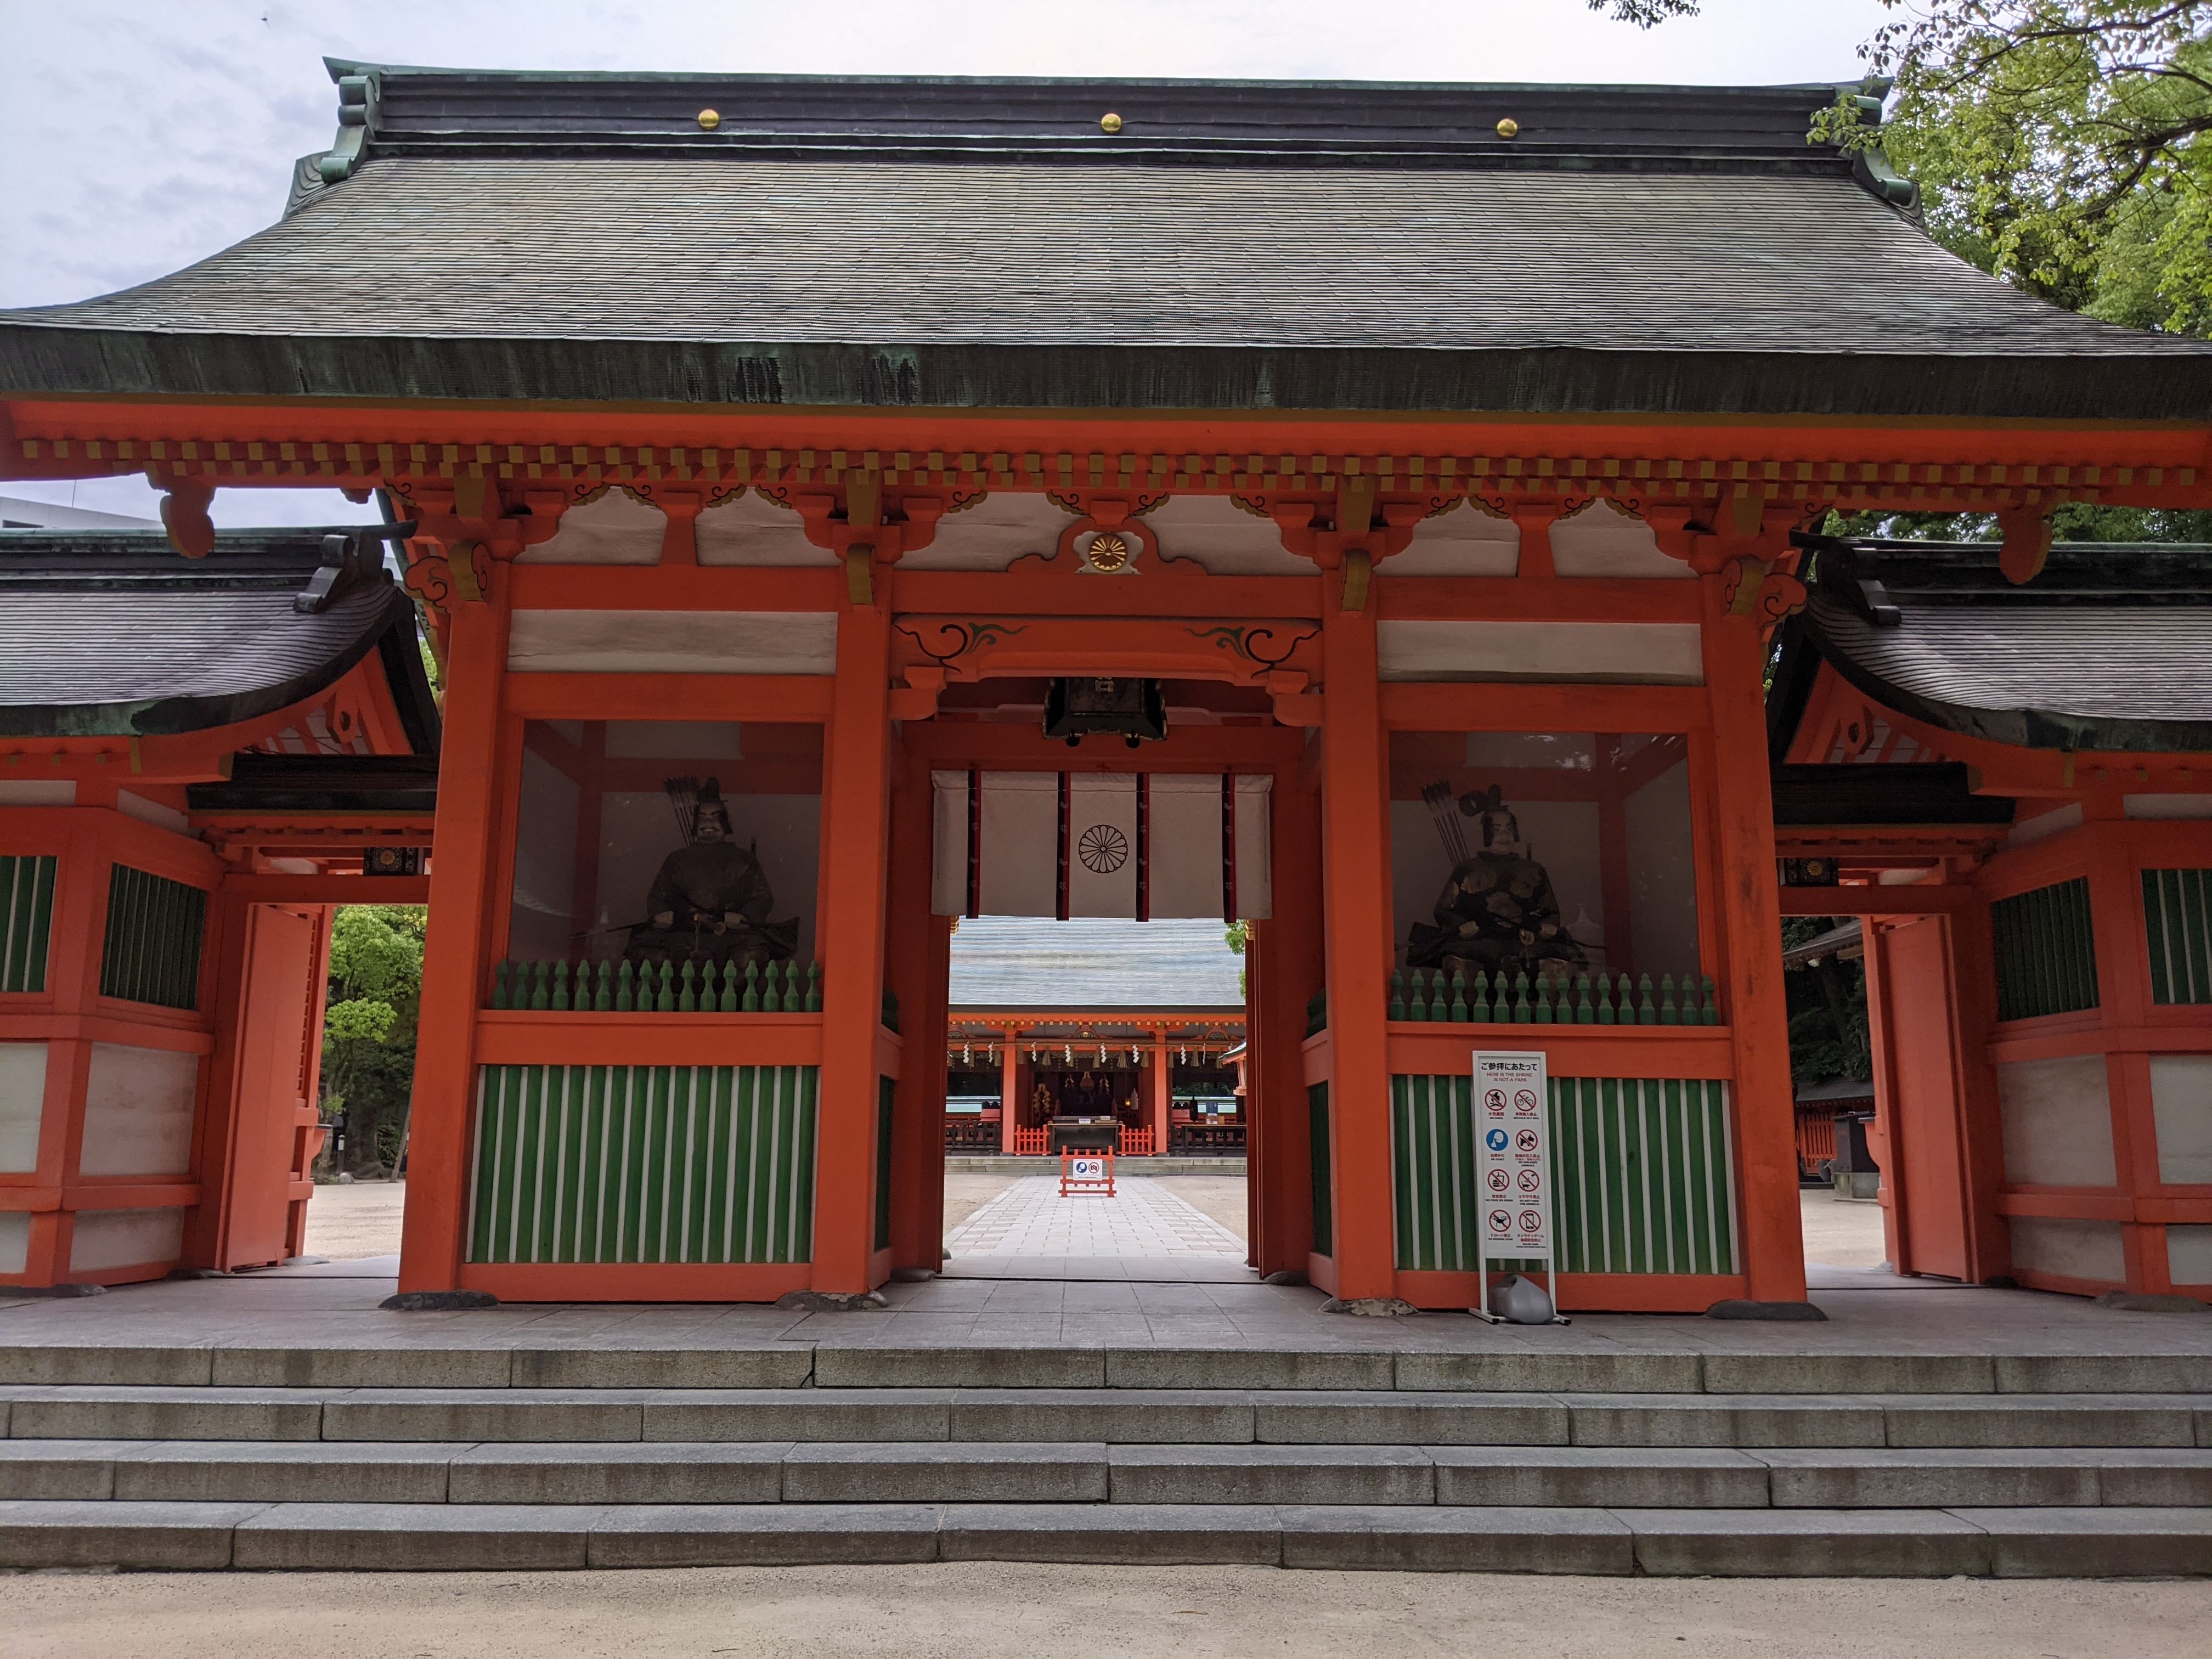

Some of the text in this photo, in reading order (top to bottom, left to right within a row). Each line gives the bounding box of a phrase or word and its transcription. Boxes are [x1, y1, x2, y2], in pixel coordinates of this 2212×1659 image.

[1481, 1063, 1537, 1071] ご参拝にあたって
